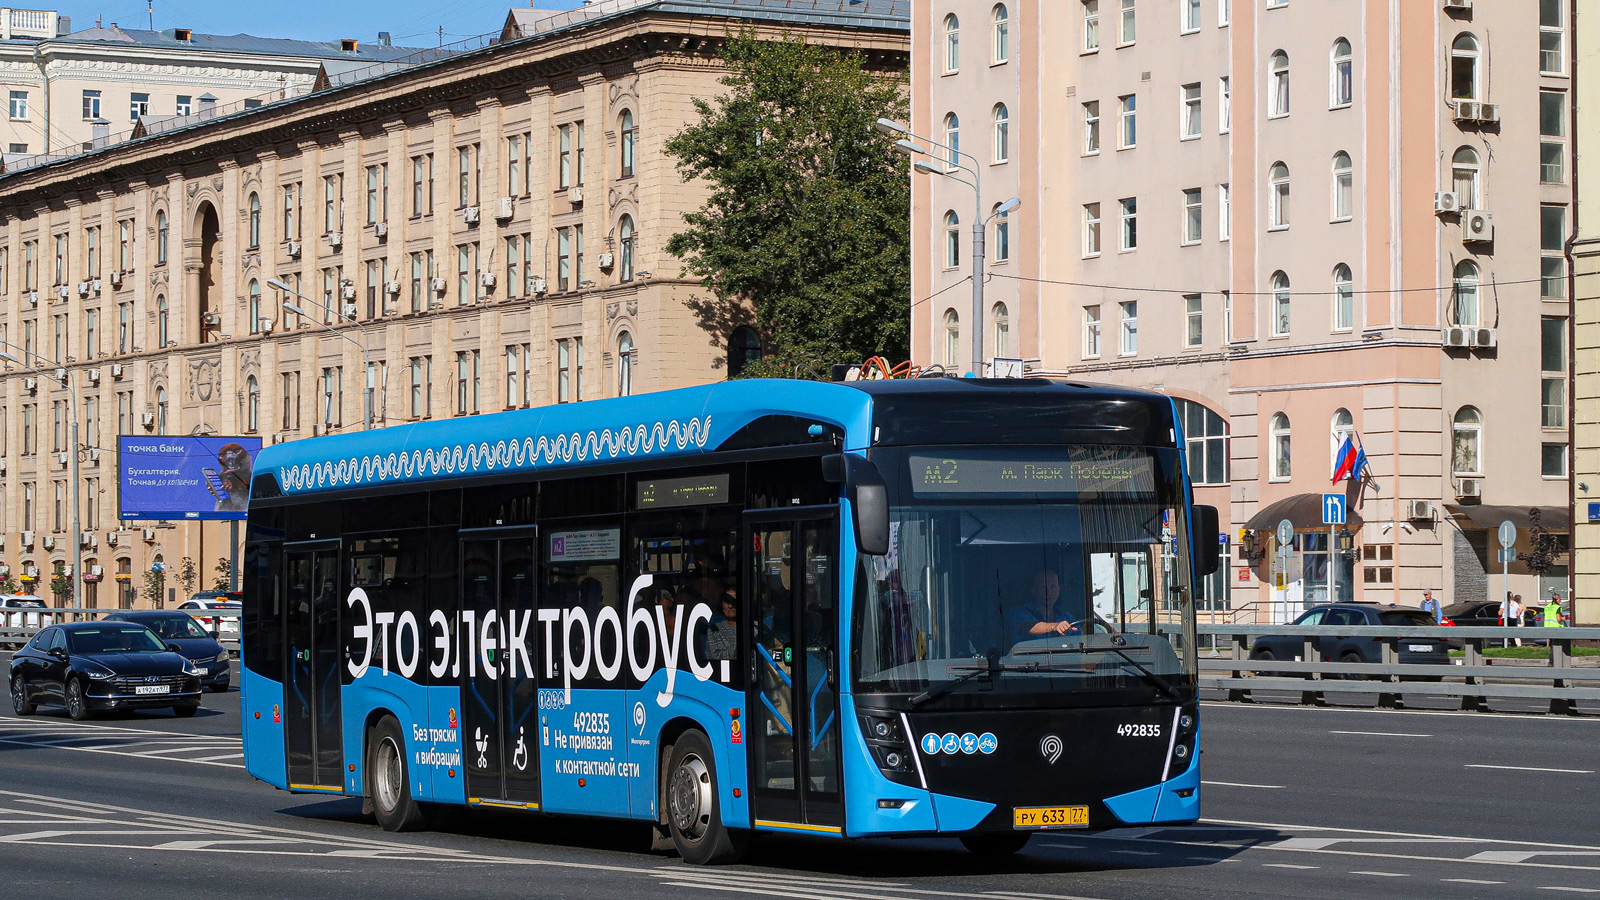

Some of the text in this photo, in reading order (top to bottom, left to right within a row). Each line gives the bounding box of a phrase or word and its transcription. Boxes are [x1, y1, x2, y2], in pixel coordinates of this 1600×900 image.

[128, 444, 184, 453] точка банк
[128, 467, 181, 477] Бухгалтерия.
[1024, 465, 1064, 481] Парк
[1070, 464, 1132, 481] Победы
[128, 478, 156, 486] Точная
[347, 587, 420, 679] Это
[573, 711, 610, 734] 492835
[1117, 724, 1161, 737] 492835
[413, 724, 457, 746] Без тряски
[554, 729, 613, 753] Не привязан
[421, 747, 461, 768] вибраций
[555, 757, 640, 778] к контактной сети
[1042, 809, 1065, 823] 633
[1072, 808, 1084, 819] 77
